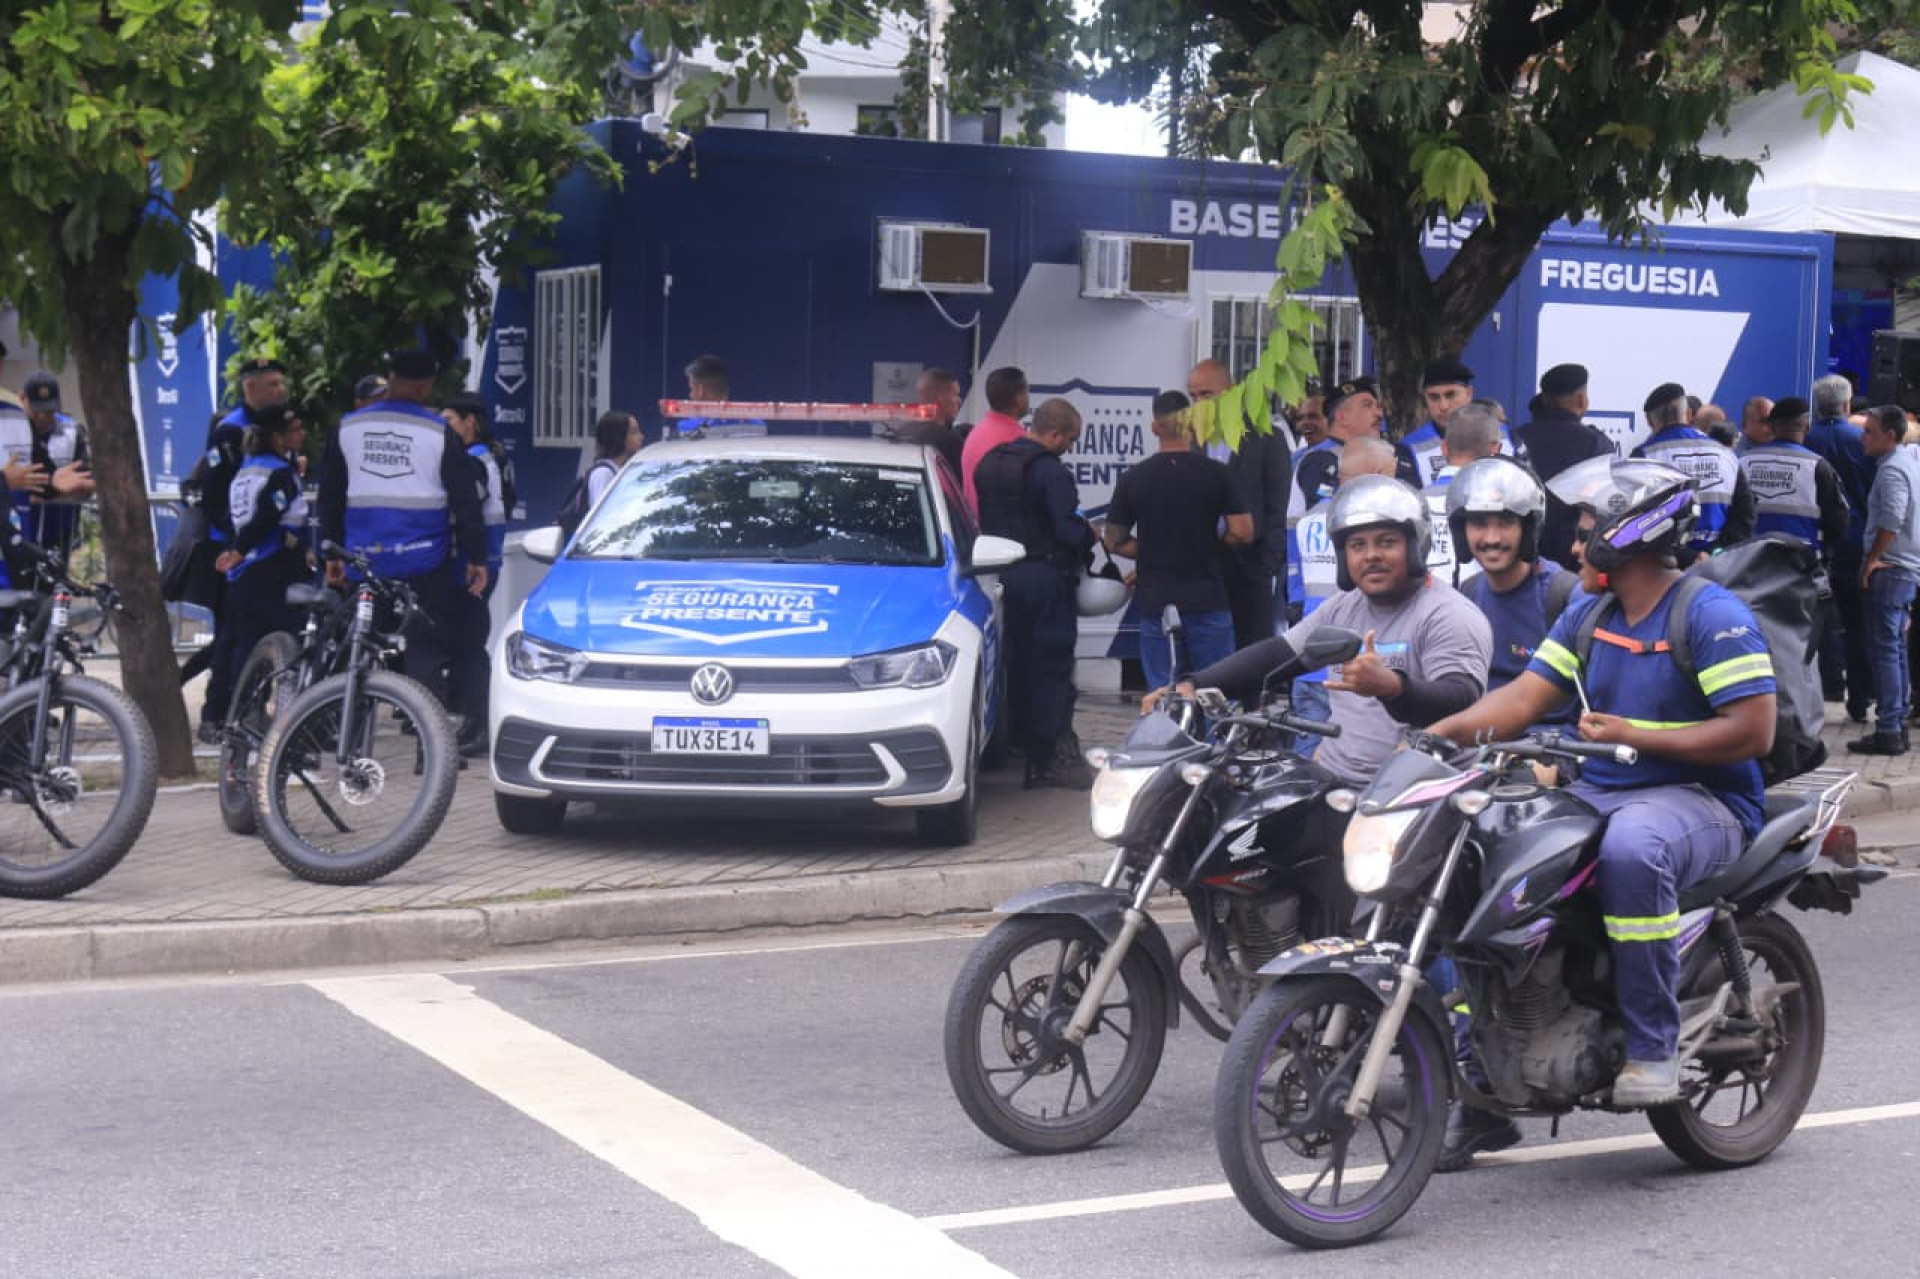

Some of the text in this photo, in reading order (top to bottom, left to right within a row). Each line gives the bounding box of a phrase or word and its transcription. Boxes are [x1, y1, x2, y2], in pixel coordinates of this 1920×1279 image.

[1169, 199, 1281, 239] BASE
[1540, 258, 1720, 297] FREGUESIA
[647, 591, 814, 611] SEGURANÇA
[640, 608, 811, 624] PRESENTE
[663, 728, 755, 752] TUX3E14
